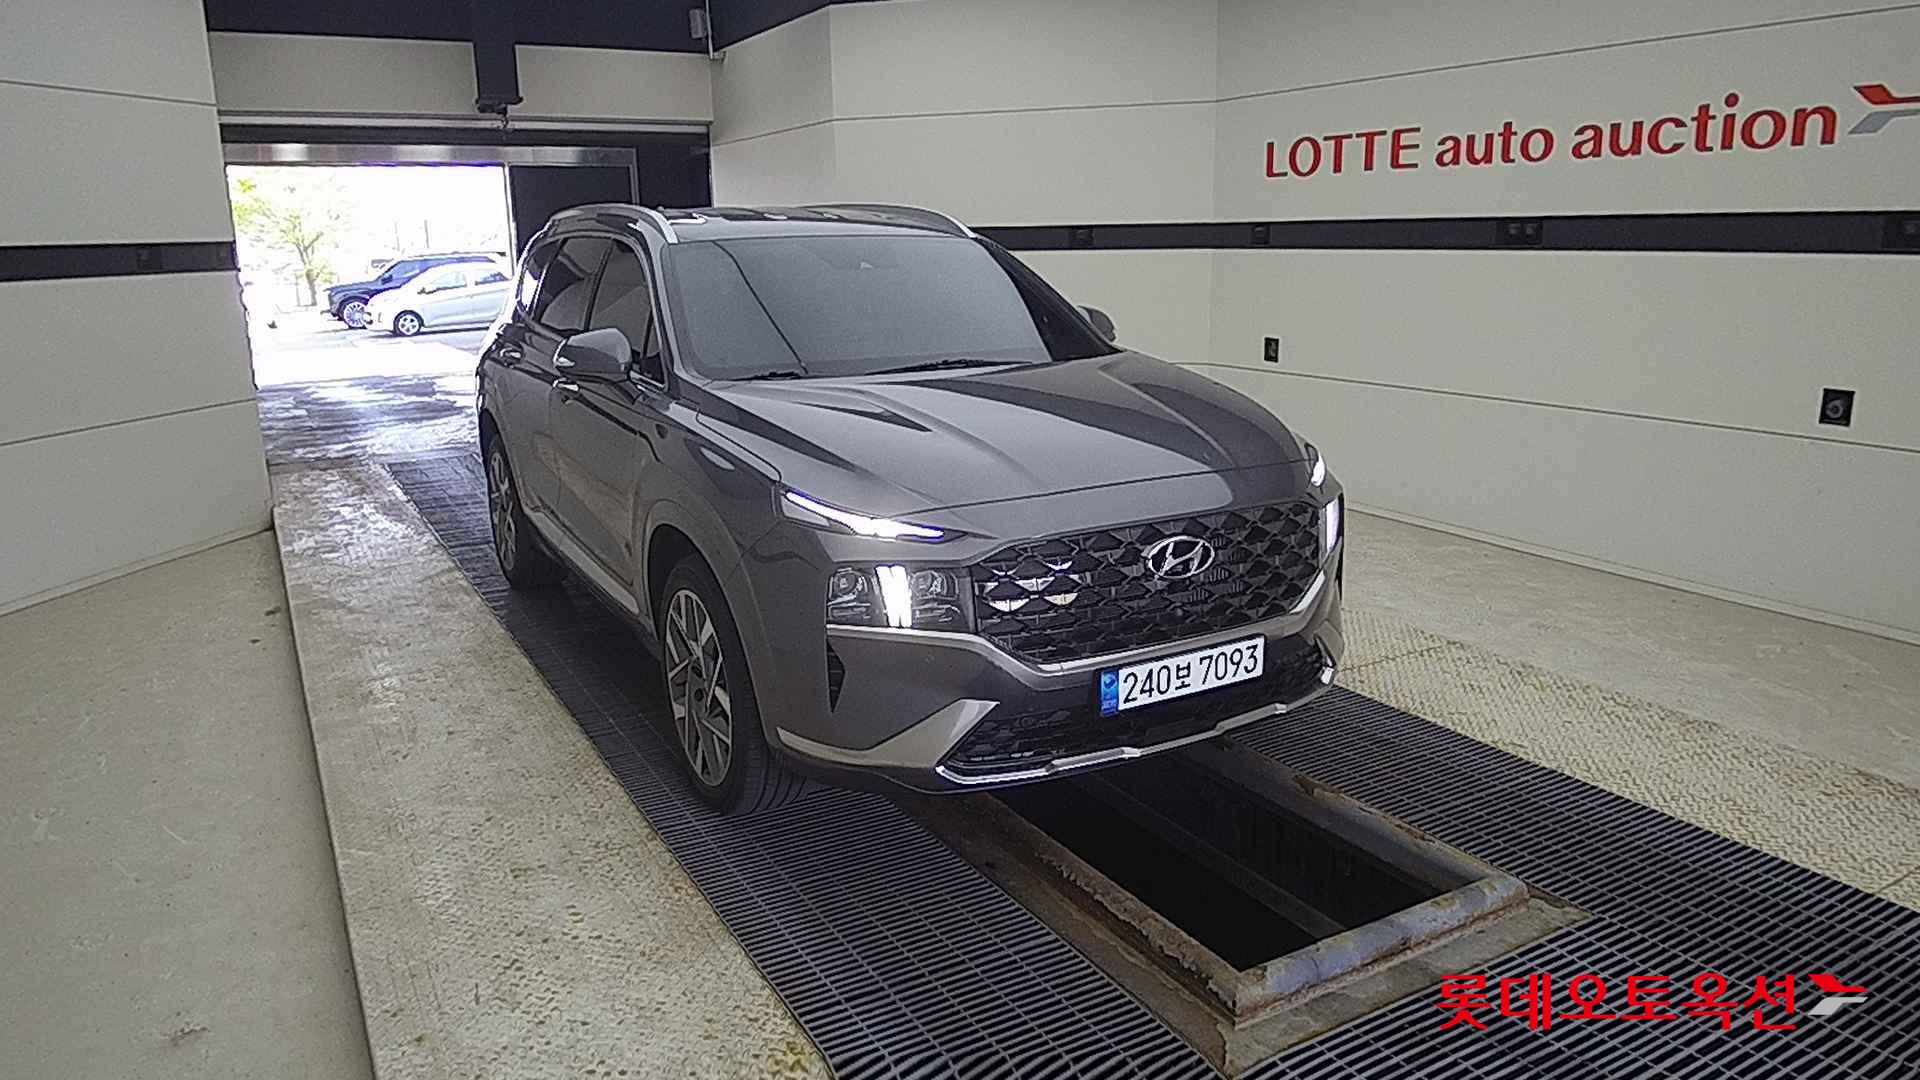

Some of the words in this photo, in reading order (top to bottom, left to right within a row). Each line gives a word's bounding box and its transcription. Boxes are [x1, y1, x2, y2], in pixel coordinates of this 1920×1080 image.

[1265, 127, 1422, 178] LOTTE
[1435, 121, 1555, 168] auto
[1571, 93, 1838, 161] auction
[1122, 661, 1192, 704] 240보
[1199, 643, 1259, 685] 7093
